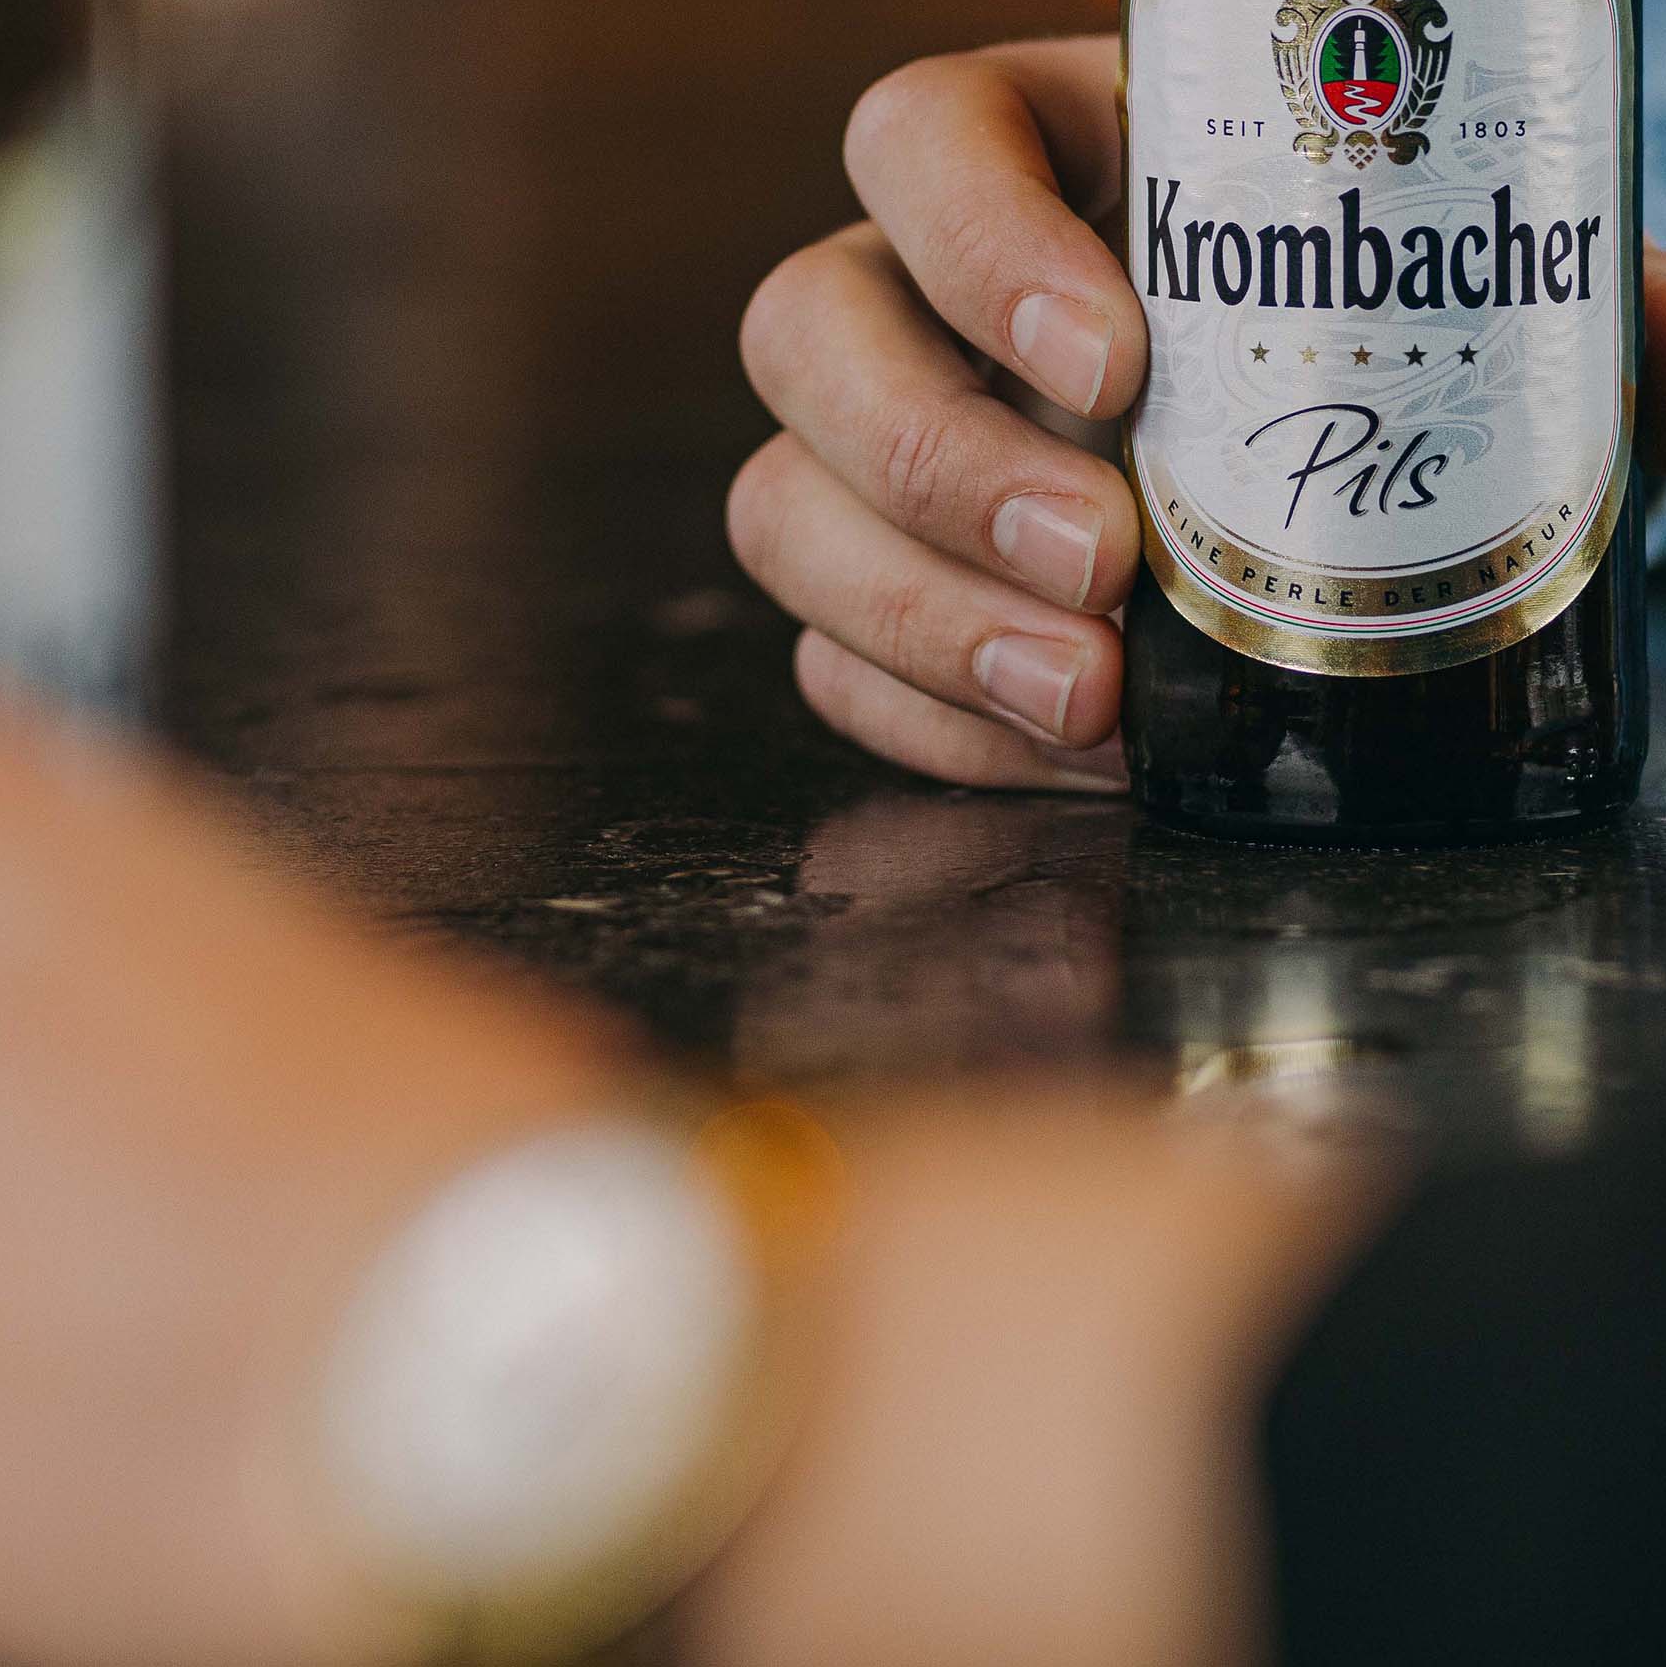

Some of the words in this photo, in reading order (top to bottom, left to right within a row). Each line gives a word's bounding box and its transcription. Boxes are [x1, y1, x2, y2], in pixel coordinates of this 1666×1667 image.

[1206, 118, 1266, 138] SEIT
[1459, 119, 1527, 140] 1803
[1145, 176, 1602, 311] Krombacher
[1244, 402, 1448, 530] Pils
[1167, 498, 1222, 566] EINE
[1241, 565, 1354, 608] PERLE
[1384, 581, 1455, 608] DER
[1478, 503, 1573, 584] NATUR
